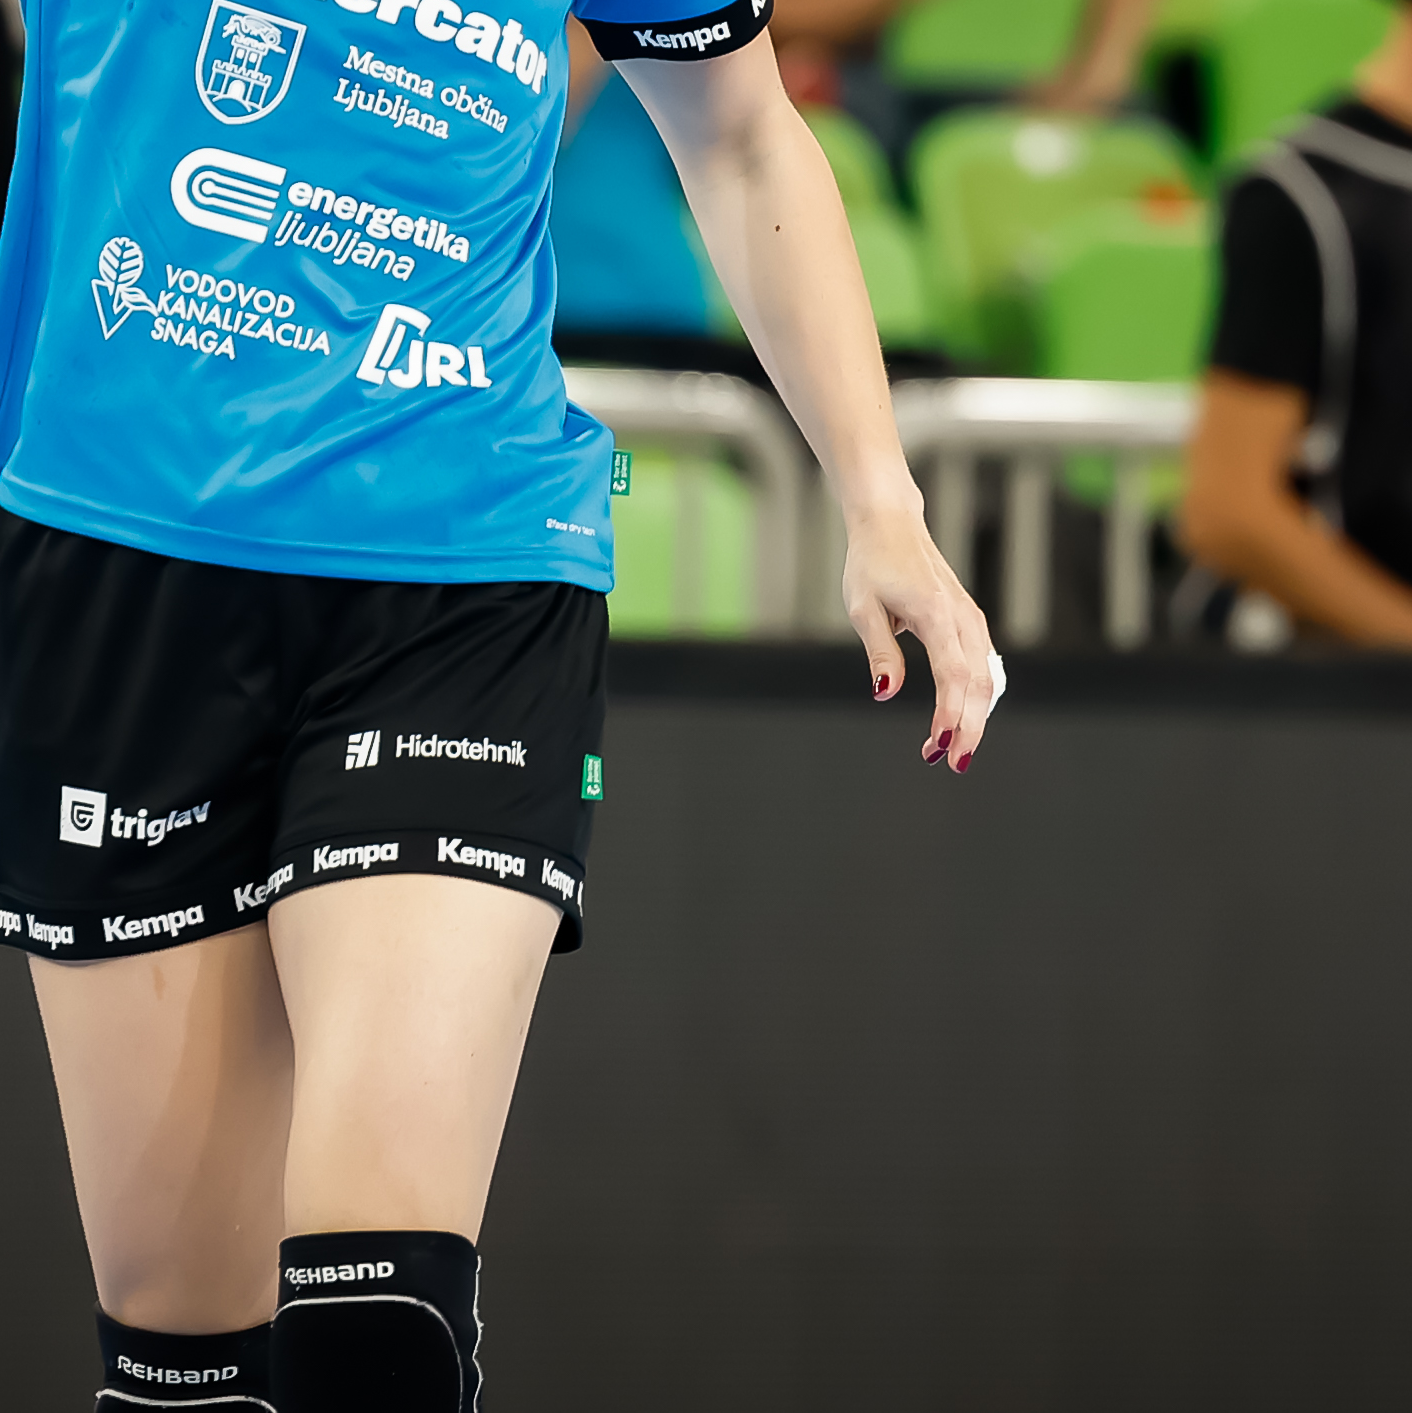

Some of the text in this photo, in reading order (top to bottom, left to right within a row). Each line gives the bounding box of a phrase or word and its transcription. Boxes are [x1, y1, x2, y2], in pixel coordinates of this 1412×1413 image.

[633, 21, 732, 52] Kempa
[333, 78, 449, 140] Ljubljana
[343, 45, 509, 134] Mestna občina
[274, 210, 416, 281] ljubljana
[288, 181, 470, 263] energetika
[165, 263, 295, 318] VODOVOD
[150, 316, 235, 360] SNAGA
[157, 290, 331, 356] KANALIZACIJA
[395, 734, 527, 767] Hidrotehnik
[110, 800, 212, 847] triglav
[26, 913, 75, 950] Kempa
[102, 905, 205, 943] Kempa
[313, 842, 400, 874] Kempa
[438, 837, 526, 879] Kempa
[541, 858, 576, 901] Kempa
